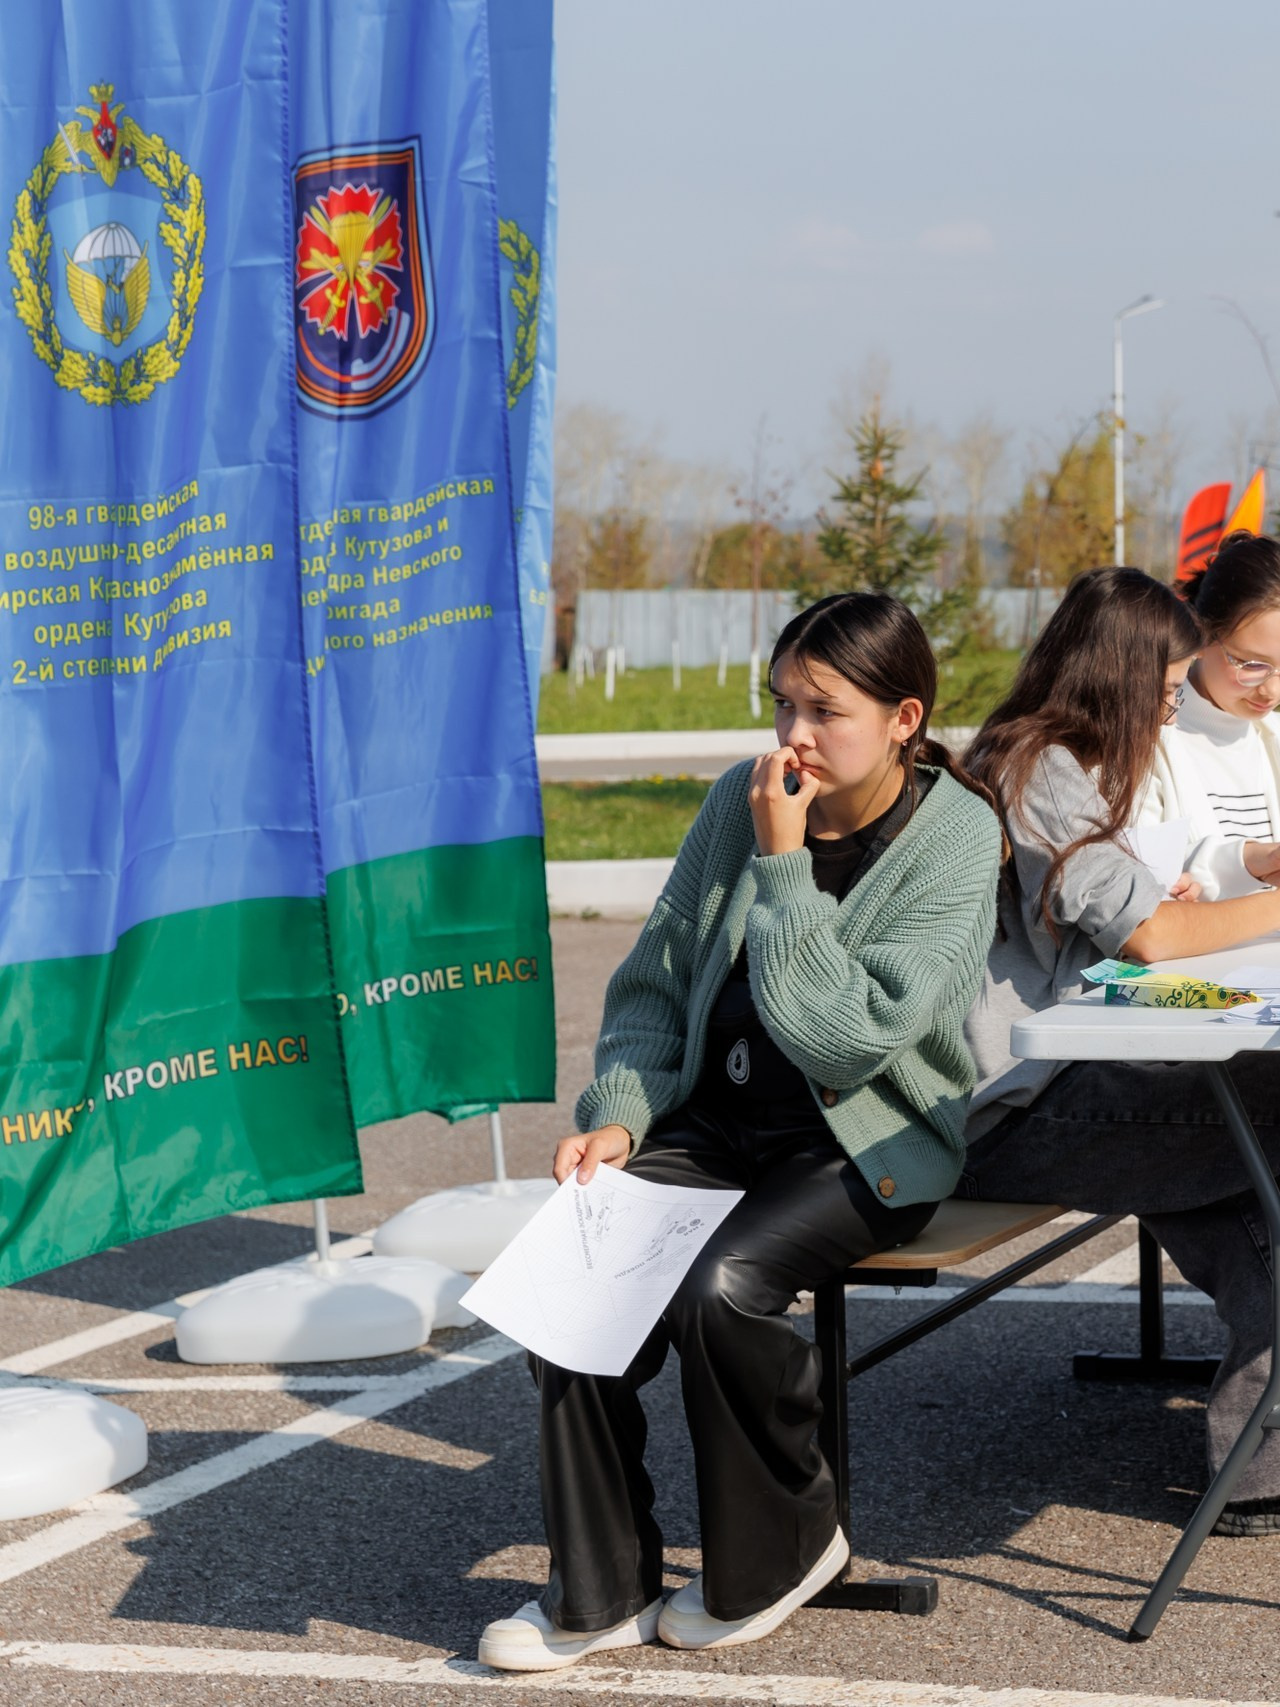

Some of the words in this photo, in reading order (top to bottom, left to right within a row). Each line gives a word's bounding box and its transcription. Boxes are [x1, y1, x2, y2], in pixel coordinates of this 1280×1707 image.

[28, 506, 77, 530] 98-я
[368, 479, 495, 523] гвардейская
[345, 524, 433, 560] Кутузова
[437, 517, 449, 533] и
[373, 545, 463, 586] Невского
[0, 584, 80, 615] ирская
[373, 604, 494, 647] назначения
[12, 657, 54, 684] 2-й
[153, 620, 232, 672] дивизия
[364, 966, 464, 1006] КРОМЕ
[474, 957, 539, 986] НАС!
[104, 1048, 219, 1101] КРОМЕ
[228, 1035, 310, 1072] НАС!
